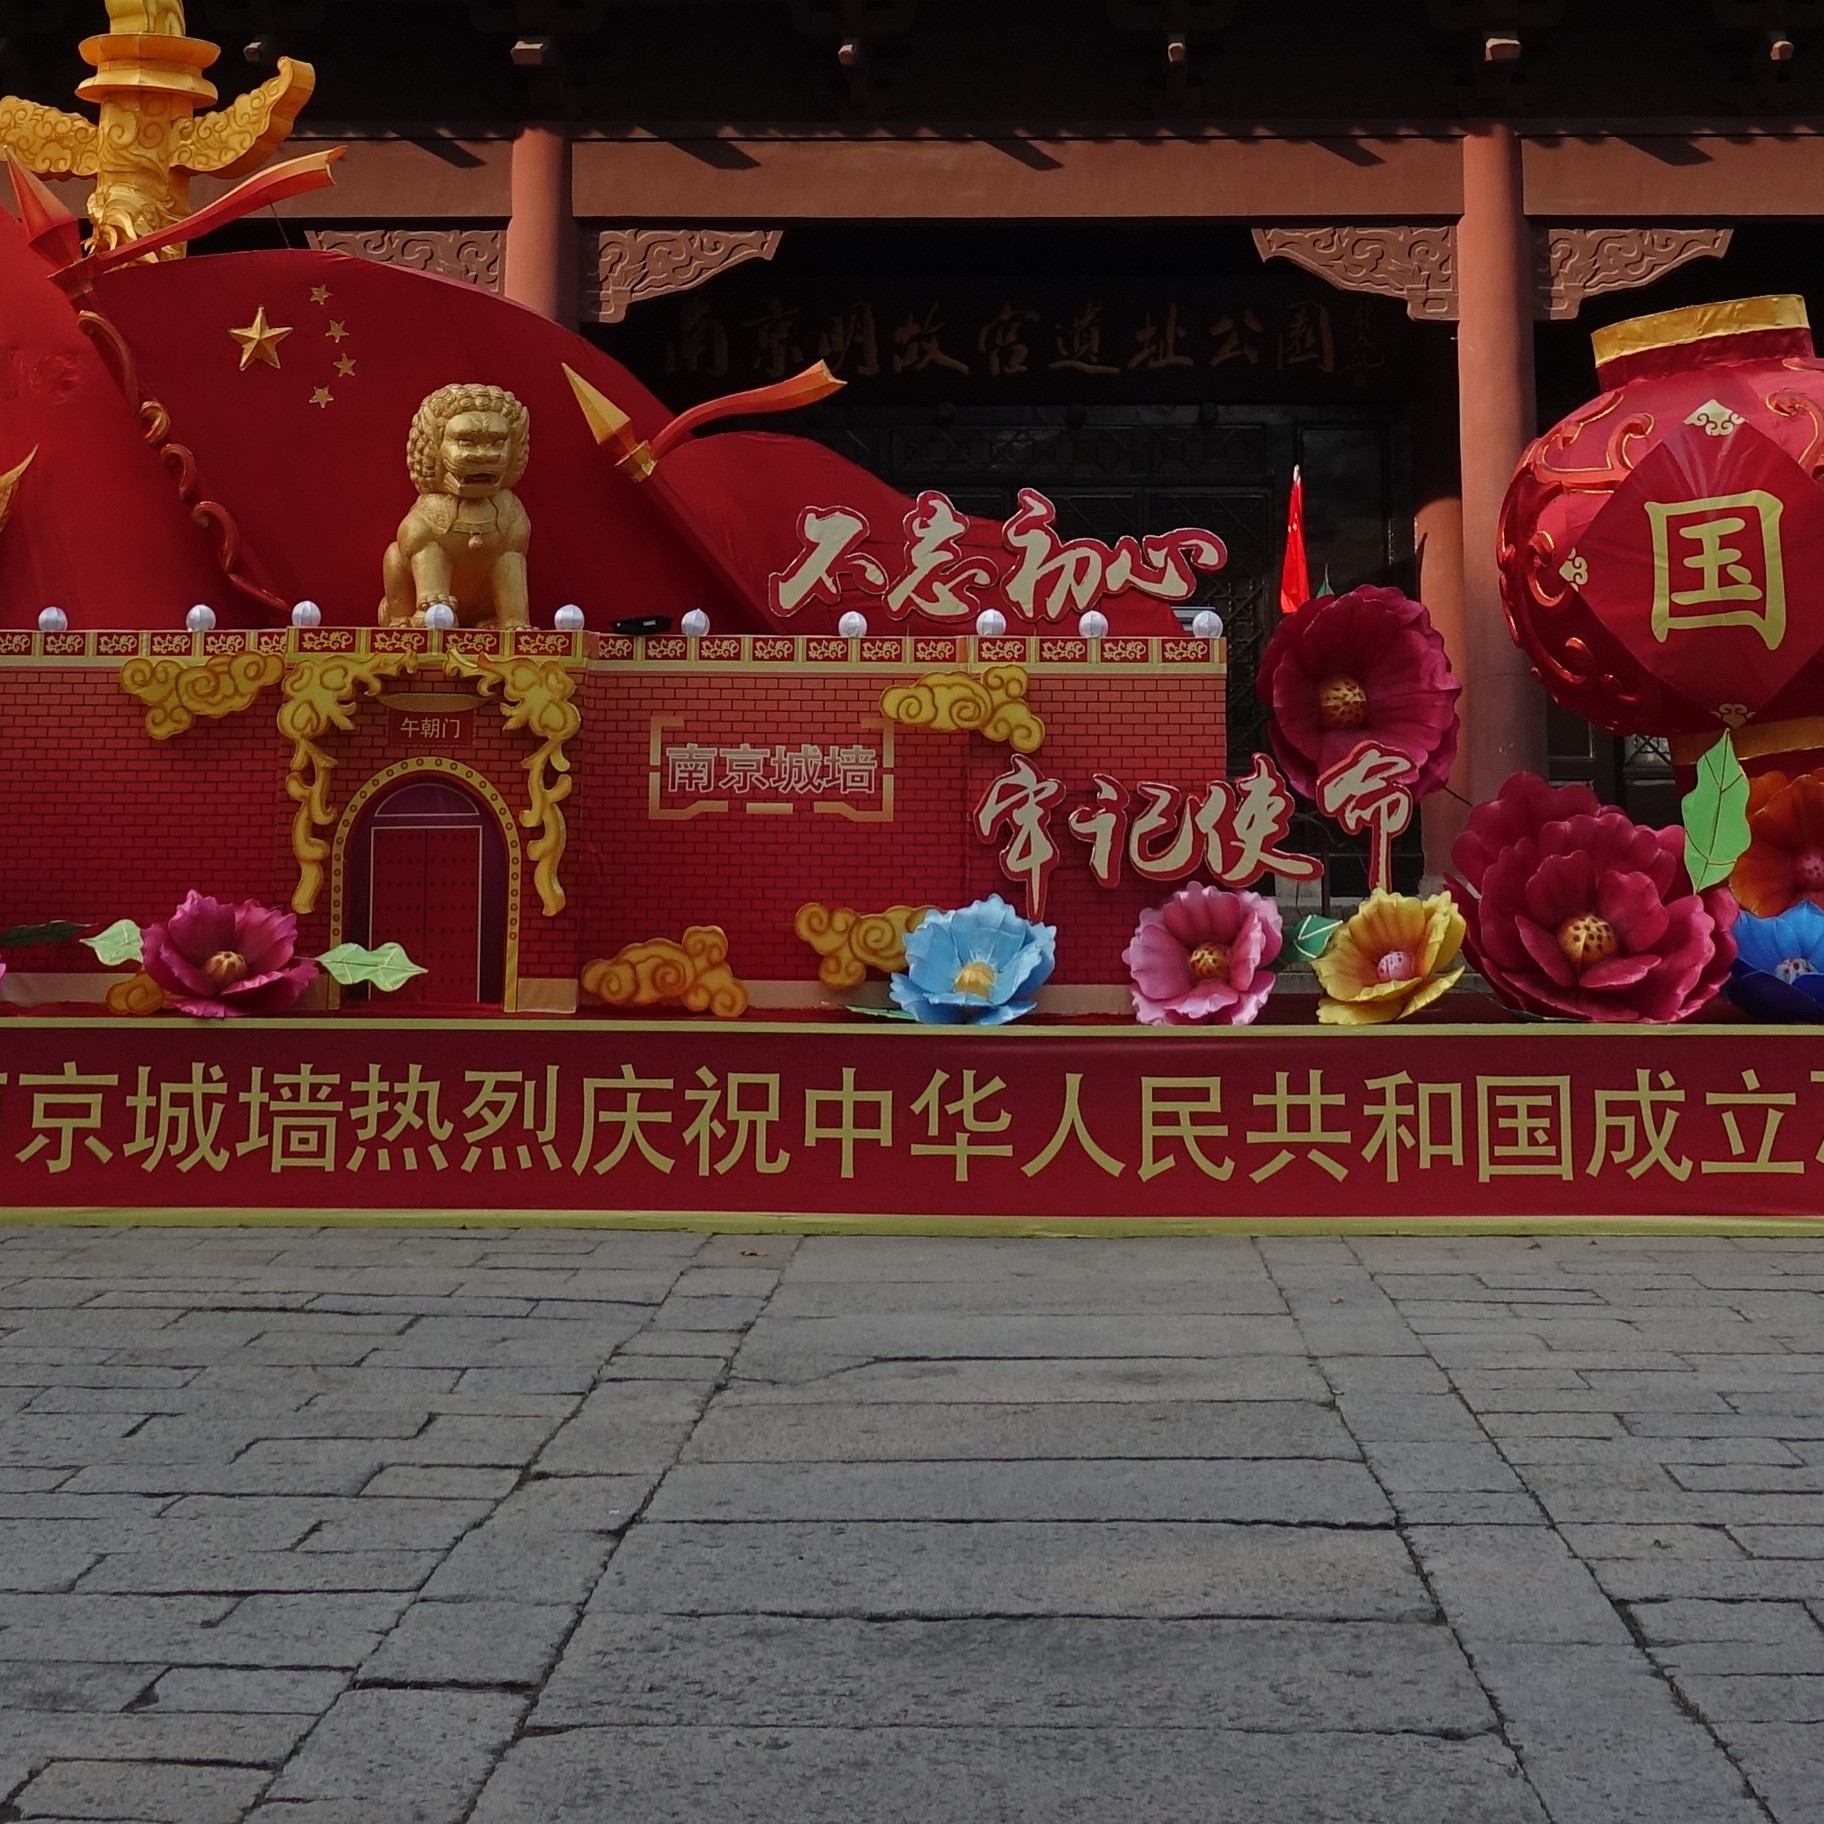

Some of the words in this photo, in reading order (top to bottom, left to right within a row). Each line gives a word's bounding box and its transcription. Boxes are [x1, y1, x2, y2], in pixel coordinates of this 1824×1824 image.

[771, 489, 1225, 622] 不忘初心
[1644, 489, 1787, 651] 国
[400, 717, 460, 738] 午朝门
[666, 743, 877, 794] 南京城墙
[976, 741, 1419, 920] 牢记使命
